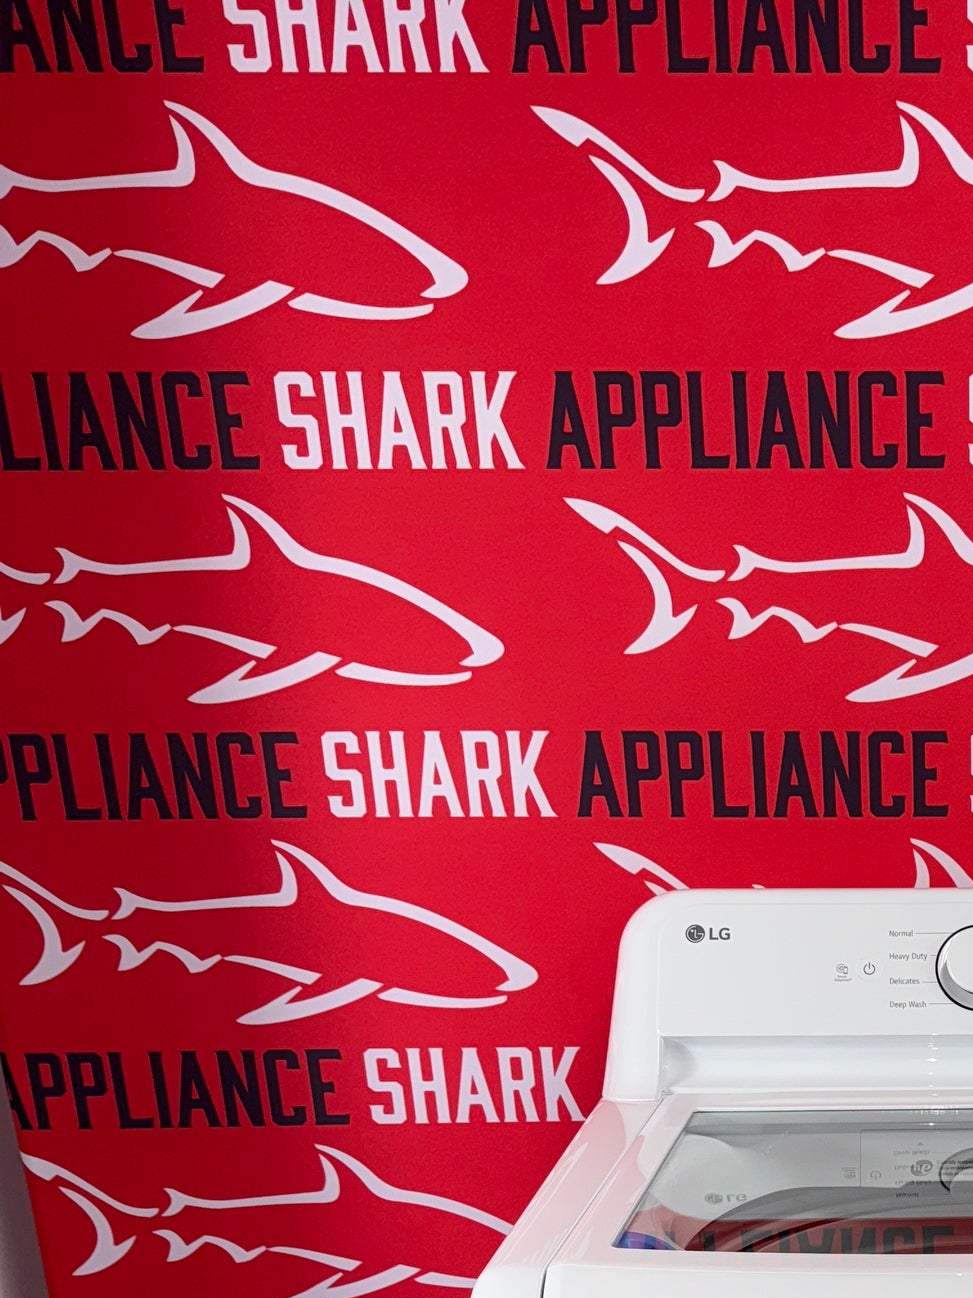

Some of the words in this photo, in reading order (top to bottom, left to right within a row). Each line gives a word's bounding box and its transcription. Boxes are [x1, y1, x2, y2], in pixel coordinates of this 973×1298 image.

[223, 0, 489, 73] SHARK
[512, 0, 941, 74] APPLIANCE
[274, 371, 525, 470] SHARK
[547, 371, 945, 470] APPLIANCE
[0, 731, 307, 821] PLIANCE
[321, 731, 557, 818] SHARK
[577, 731, 949, 818] APPLIANCE
[888, 930, 914, 938] Normal
[889, 952, 910, 961] Heavy
[911, 952, 928, 961] Duty
[889, 977, 920, 985] Delicates
[889, 1001, 907, 1009] Deep
[908, 1000, 927, 1008] Wash
[364, 1046, 586, 1123] SHARK
